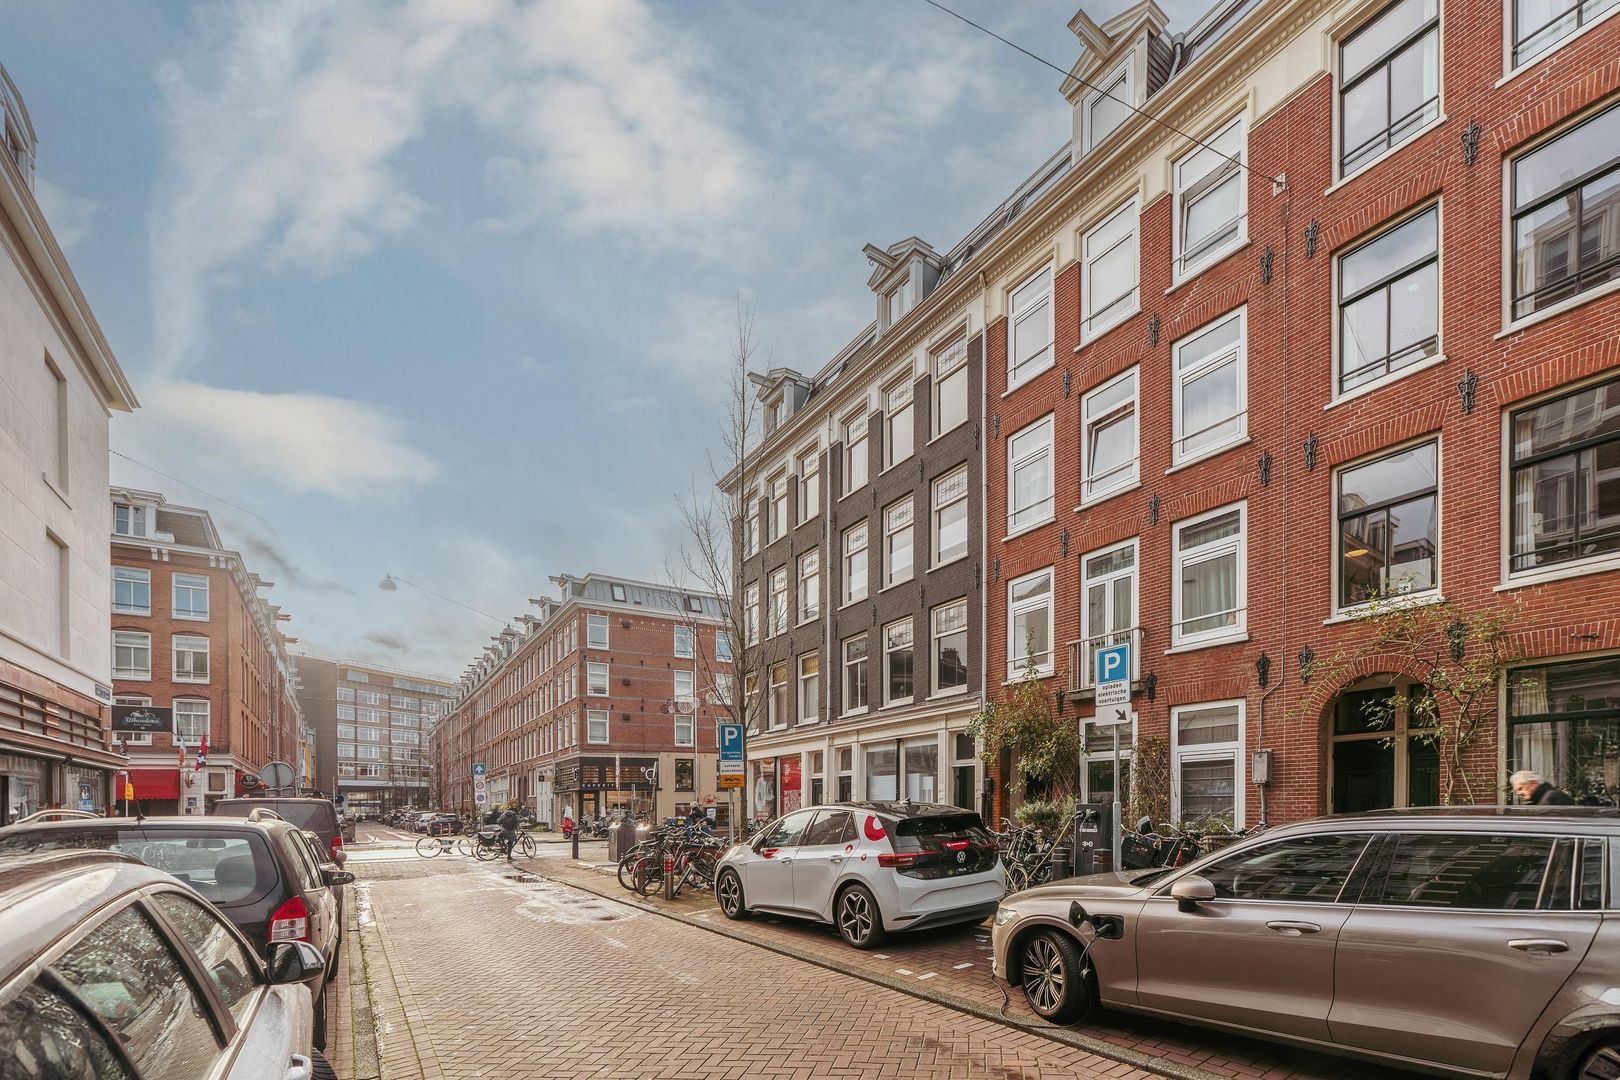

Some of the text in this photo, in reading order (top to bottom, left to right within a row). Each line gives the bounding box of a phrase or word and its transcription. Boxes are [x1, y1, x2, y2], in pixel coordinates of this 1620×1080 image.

[1104, 652, 1120, 679] P
[1098, 689, 1127, 698] elektrische
[1098, 696, 1127, 704] voertuigen
[724, 726, 738, 746] P
